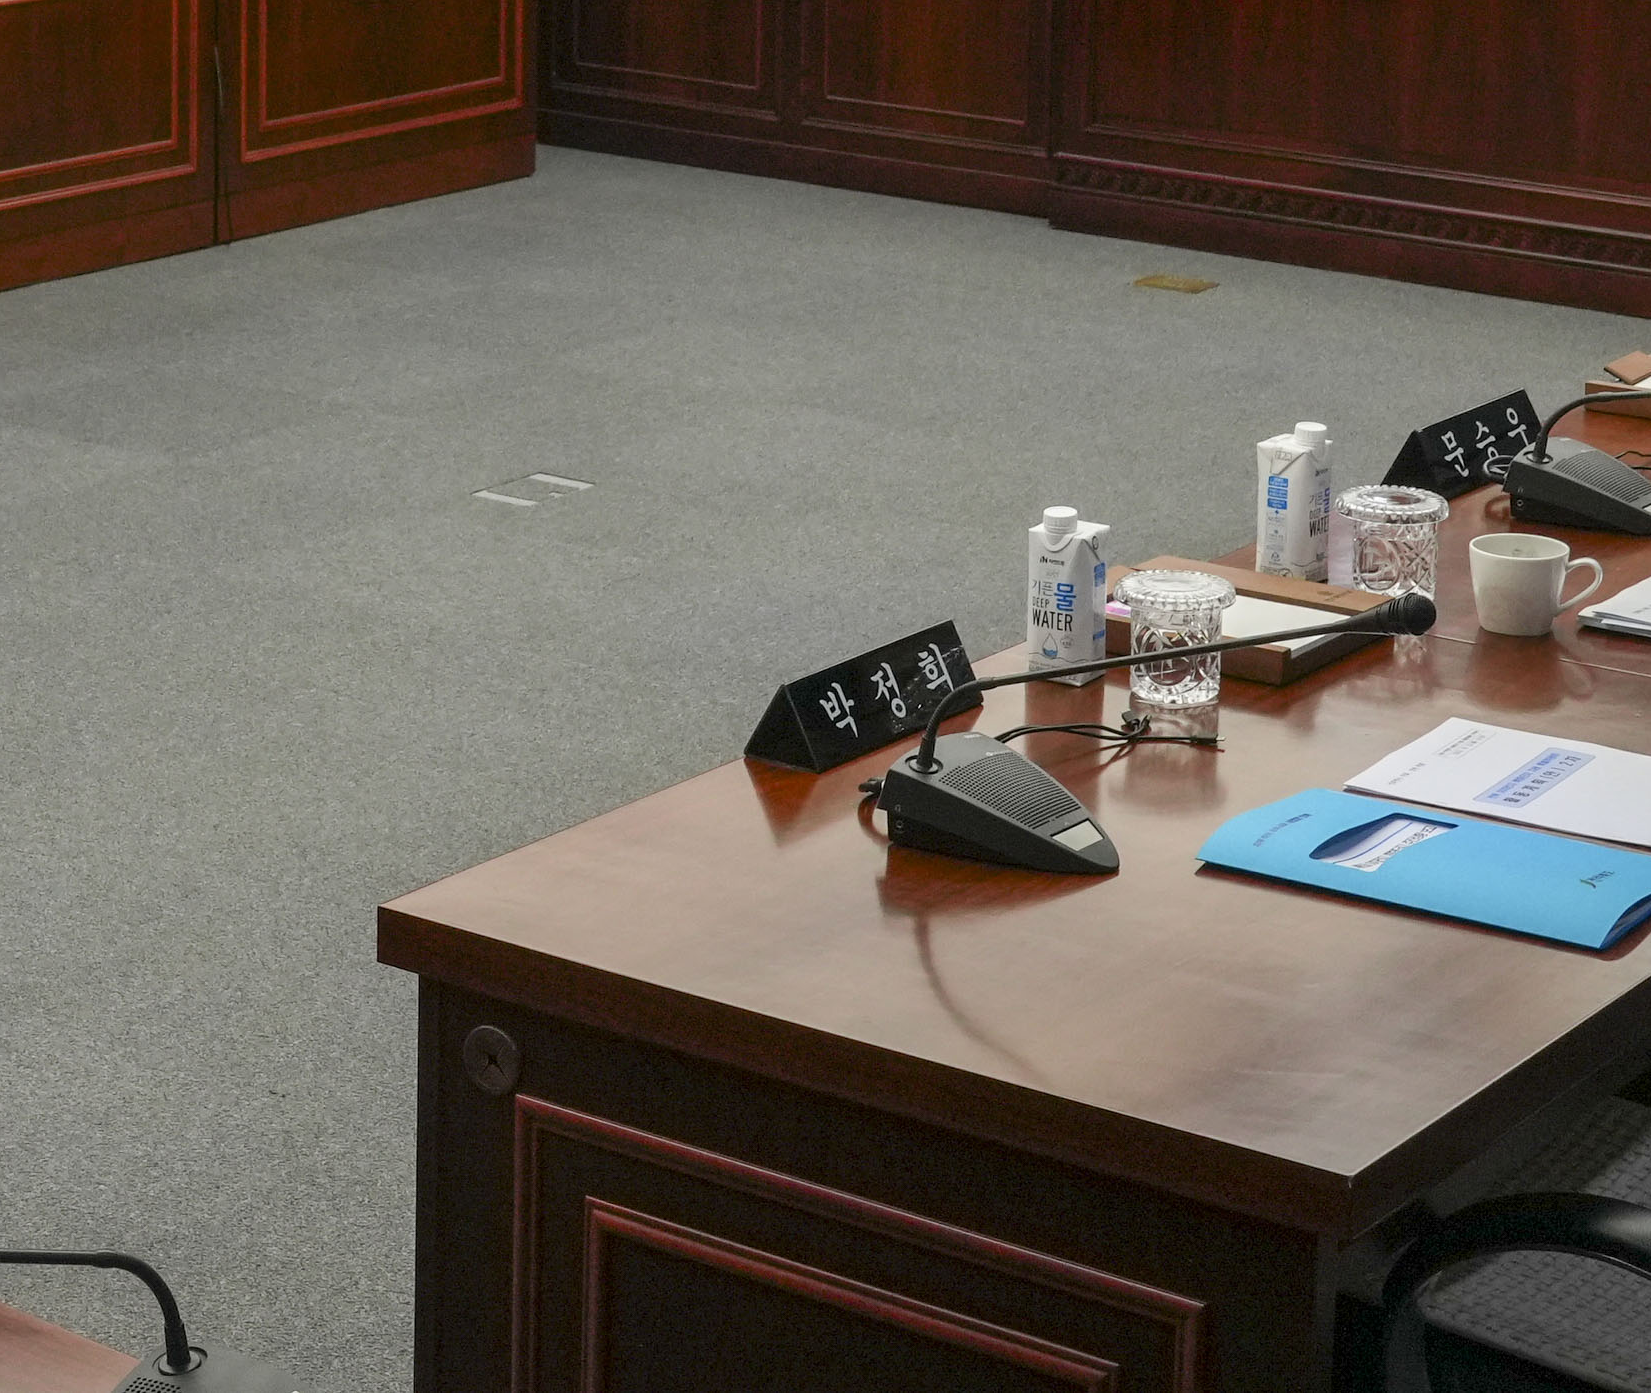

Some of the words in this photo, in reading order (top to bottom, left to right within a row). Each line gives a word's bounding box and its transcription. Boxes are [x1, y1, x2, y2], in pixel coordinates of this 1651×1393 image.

[1440, 407, 1529, 478] 문승우
[1032, 596, 1050, 609] DEEP
[1053, 582, 1077, 612] 물
[1032, 608, 1074, 632] WATER
[819, 642, 955, 739] 박정희
